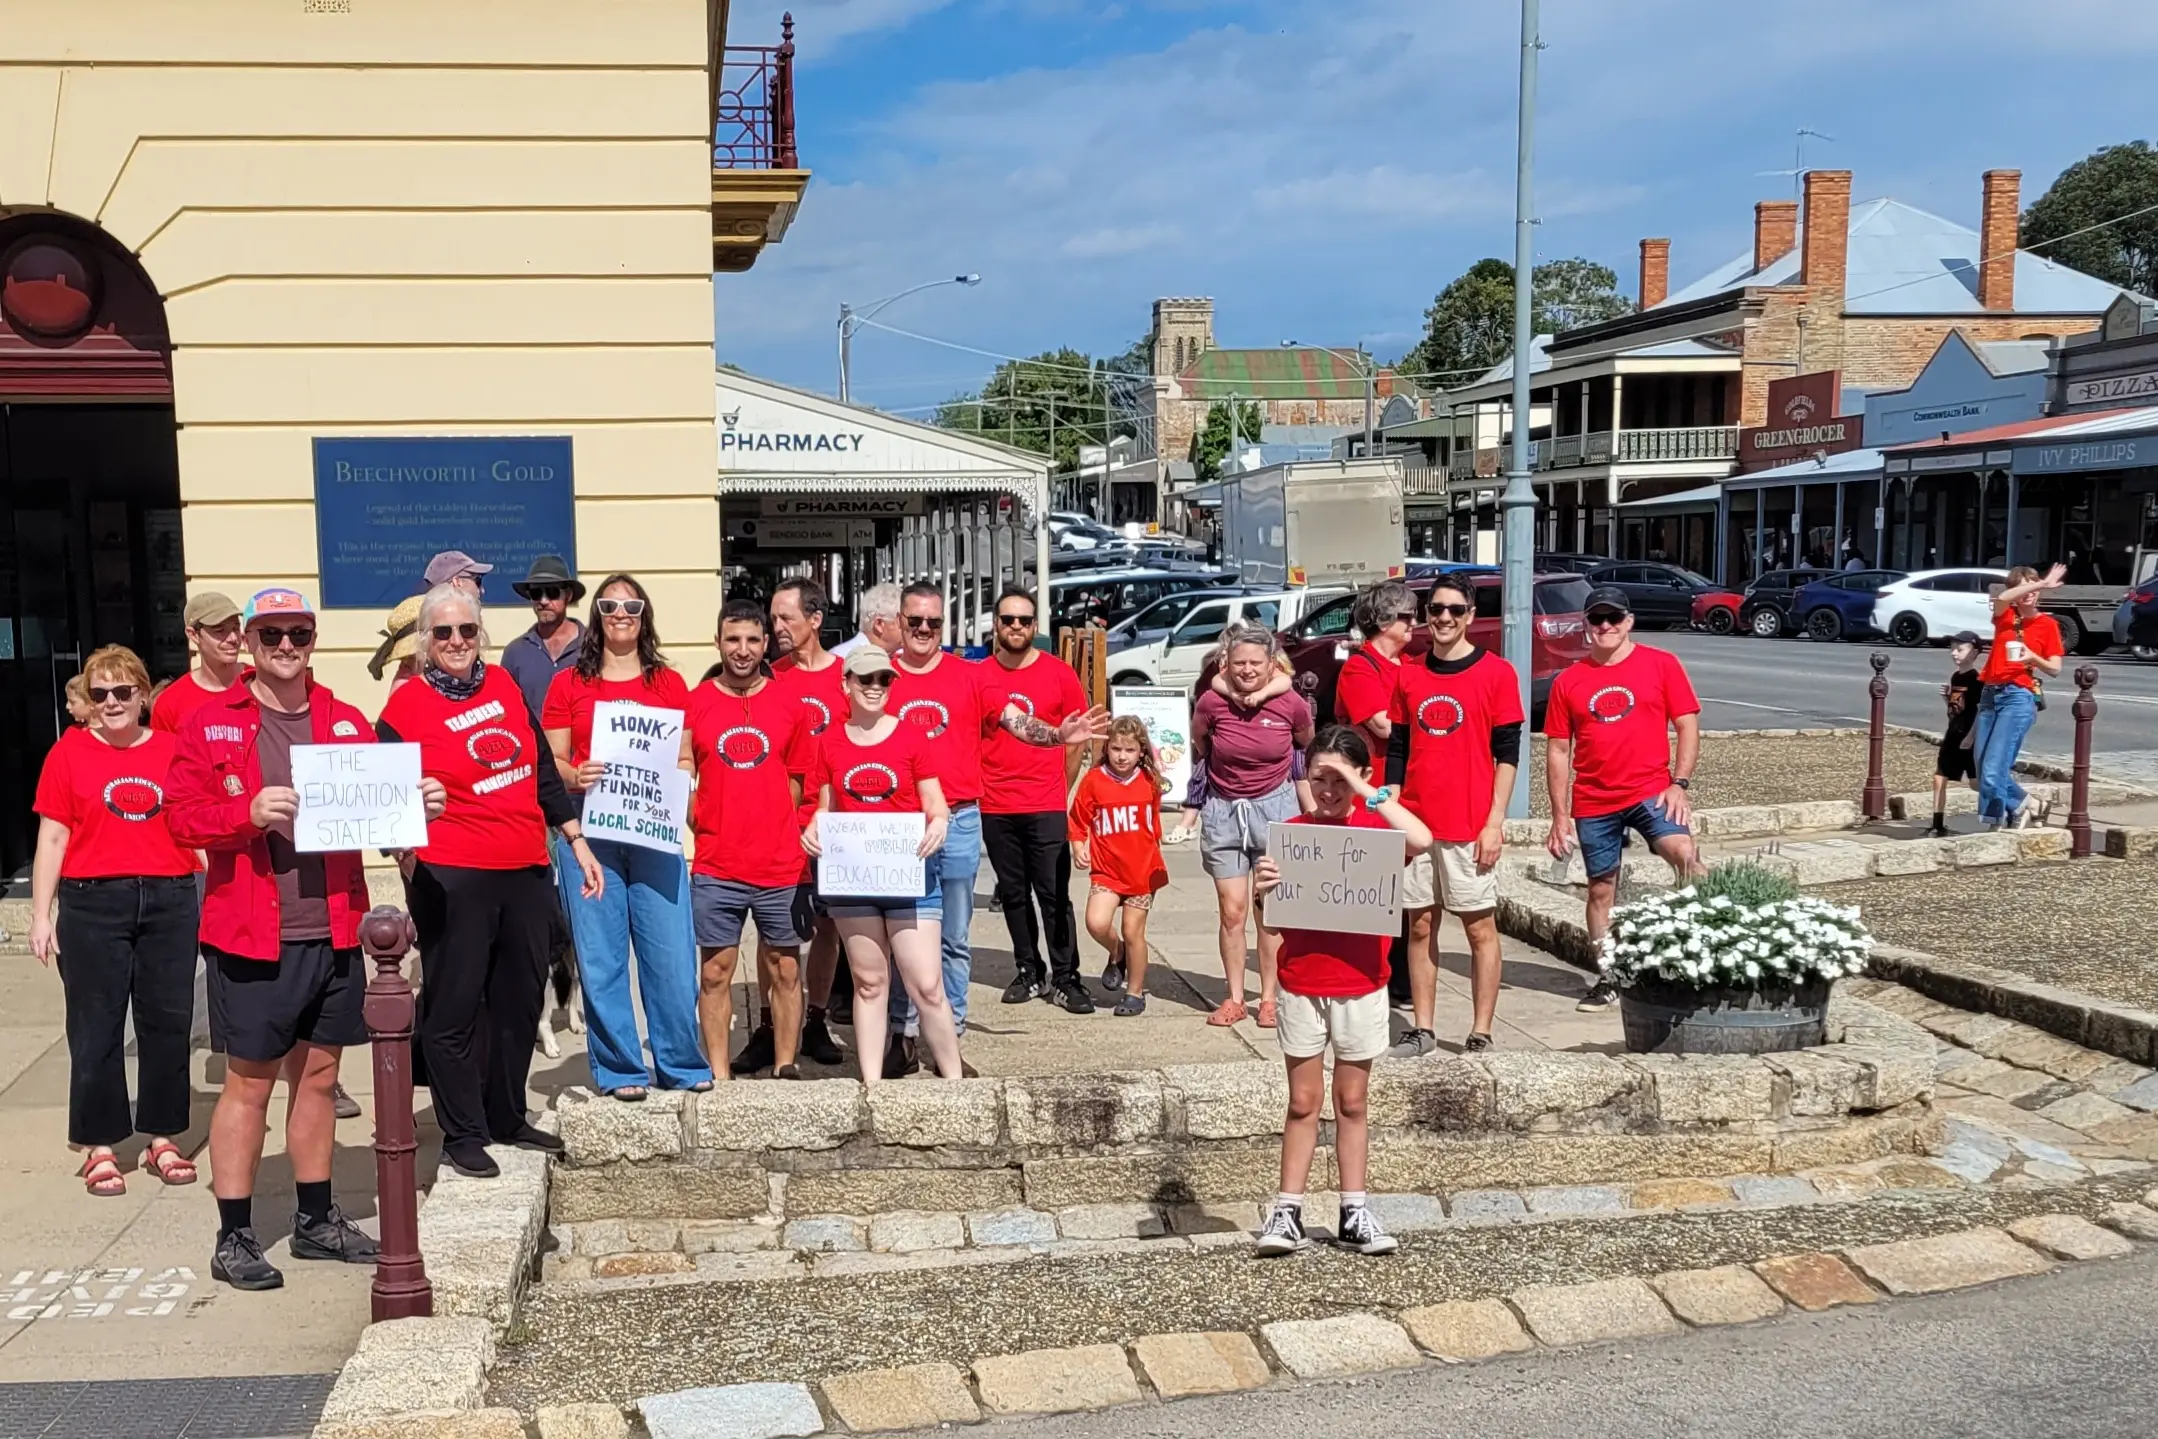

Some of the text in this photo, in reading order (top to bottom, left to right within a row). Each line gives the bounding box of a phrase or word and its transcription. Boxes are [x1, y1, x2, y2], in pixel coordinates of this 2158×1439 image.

[2079, 375, 2158, 400] PIZZA
[721, 433, 864, 451] PHARMACY
[1754, 423, 1846, 449] GREENGROCER
[2039, 443, 2136, 467] IVY PHILLIPS
[335, 460, 554, 483] BEECHWORTH GOLD
[795, 501, 908, 513] PHARMACY
[853, 530, 872, 539] ATM
[443, 699, 505, 733] TEACHERS
[610, 714, 679, 741] HONK!
[628, 737, 651, 753] FOR
[316, 749, 367, 772] THE
[471, 763, 532, 796] PRINCIPALS
[603, 761, 661, 787] BETTER
[304, 782, 408, 809] EDUCATION
[600, 778, 663, 804] FUNDING
[123, 811, 147, 821] UNION
[622, 798, 672, 822] FOR YOUR
[316, 811, 402, 846] STATE?
[588, 809, 682, 846] LOCAL SCHOOL
[826, 821, 868, 835] WEAR
[864, 838, 918, 855] PUBLIC
[1281, 833, 1368, 873] Honk for
[1275, 873, 1397, 916] our school!
